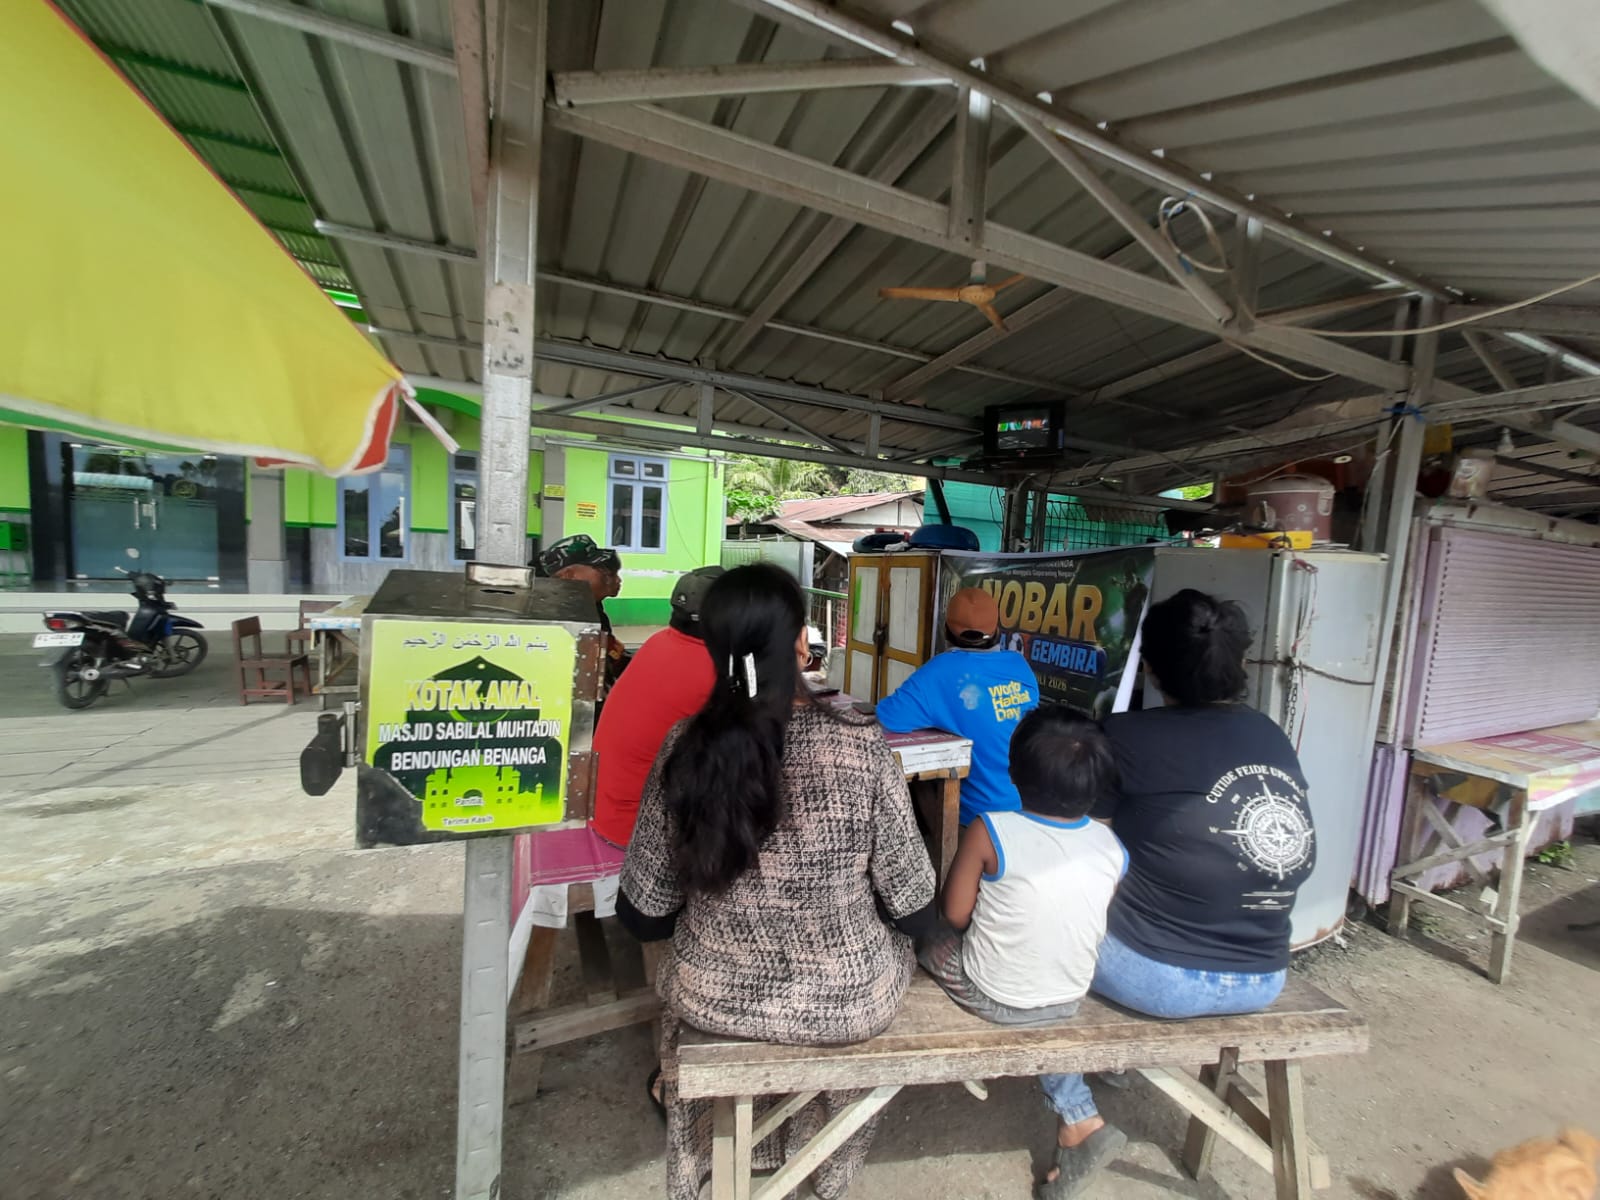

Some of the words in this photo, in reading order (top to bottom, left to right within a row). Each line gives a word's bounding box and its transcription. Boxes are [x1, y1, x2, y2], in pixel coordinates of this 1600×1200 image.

[1031, 639, 1098, 674] GEMBIRA
[406, 680, 483, 711] KOTAK
[484, 680, 542, 710] AMAL
[995, 706, 1021, 722] Day
[379, 722, 433, 742] MASJID
[436, 722, 493, 740] SABILAL
[496, 720, 561, 738] MUHTADIN
[391, 749, 480, 770] BENDUNGAN
[484, 747, 546, 766] BENANGA
